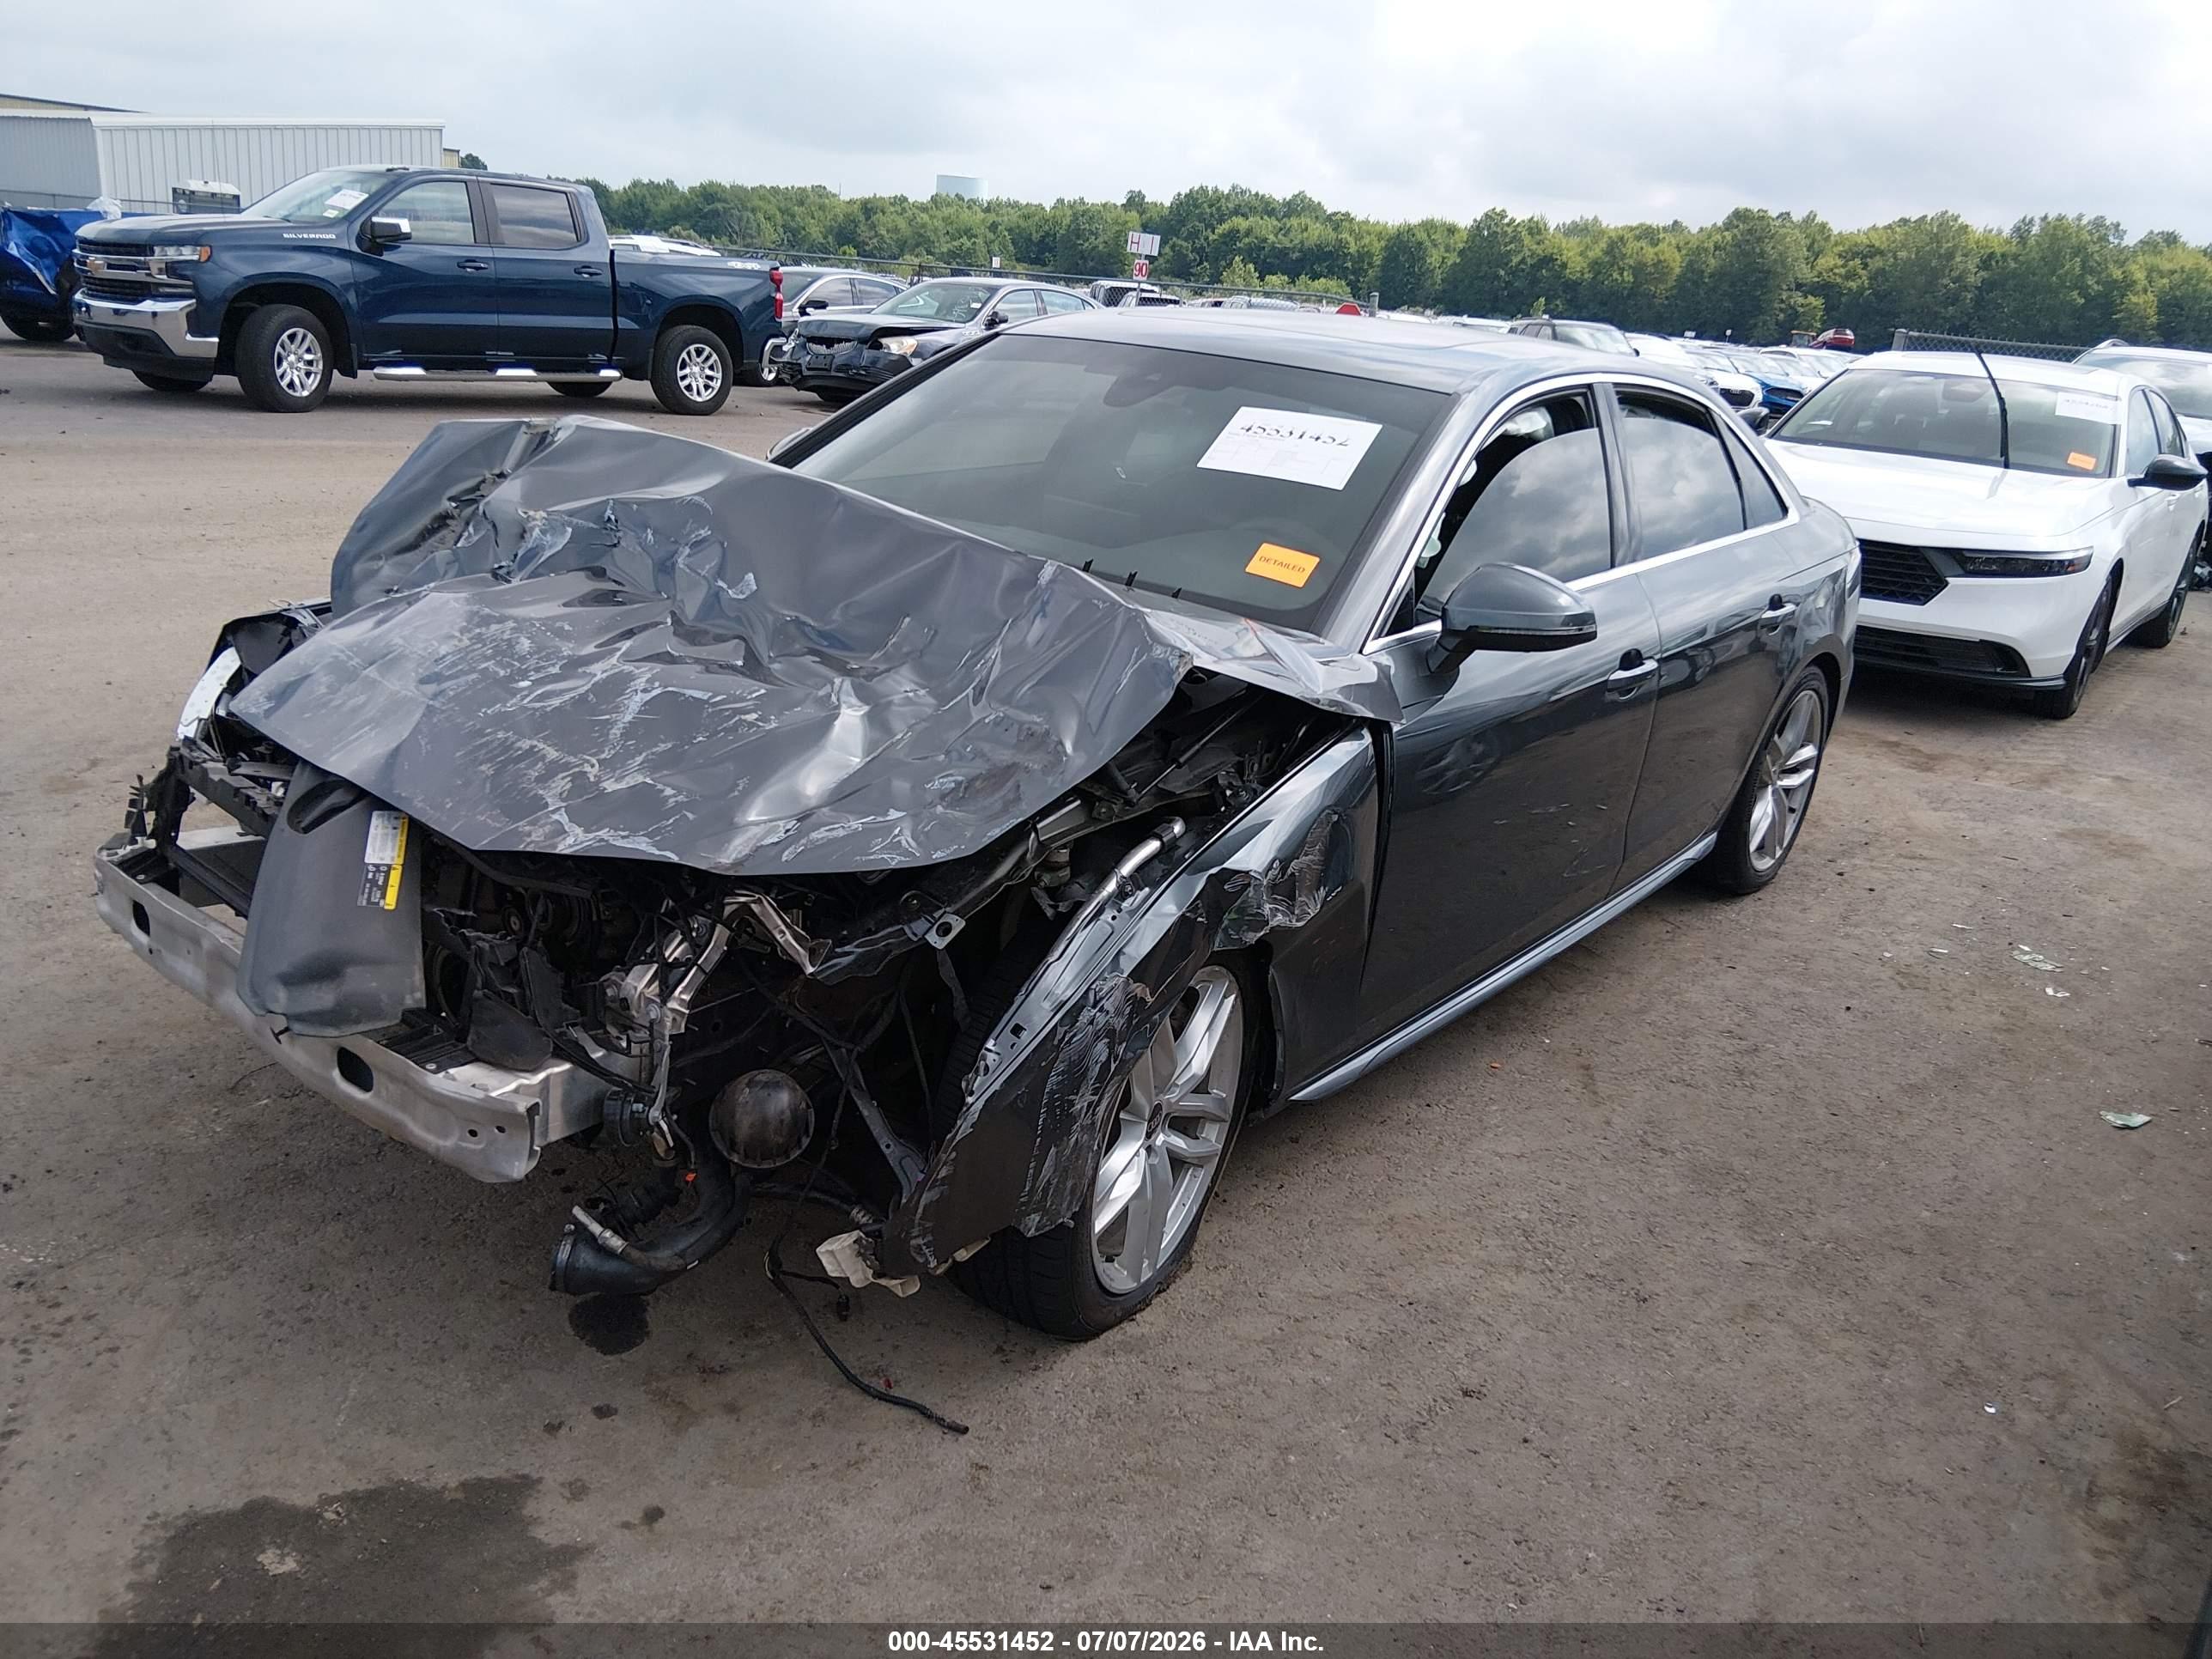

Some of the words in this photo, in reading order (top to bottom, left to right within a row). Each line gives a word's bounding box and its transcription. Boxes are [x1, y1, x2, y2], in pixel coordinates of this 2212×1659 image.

[1130, 233, 1140, 252] H
[1134, 262, 1148, 277] 90
[1259, 556, 1306, 574] DETAILED
